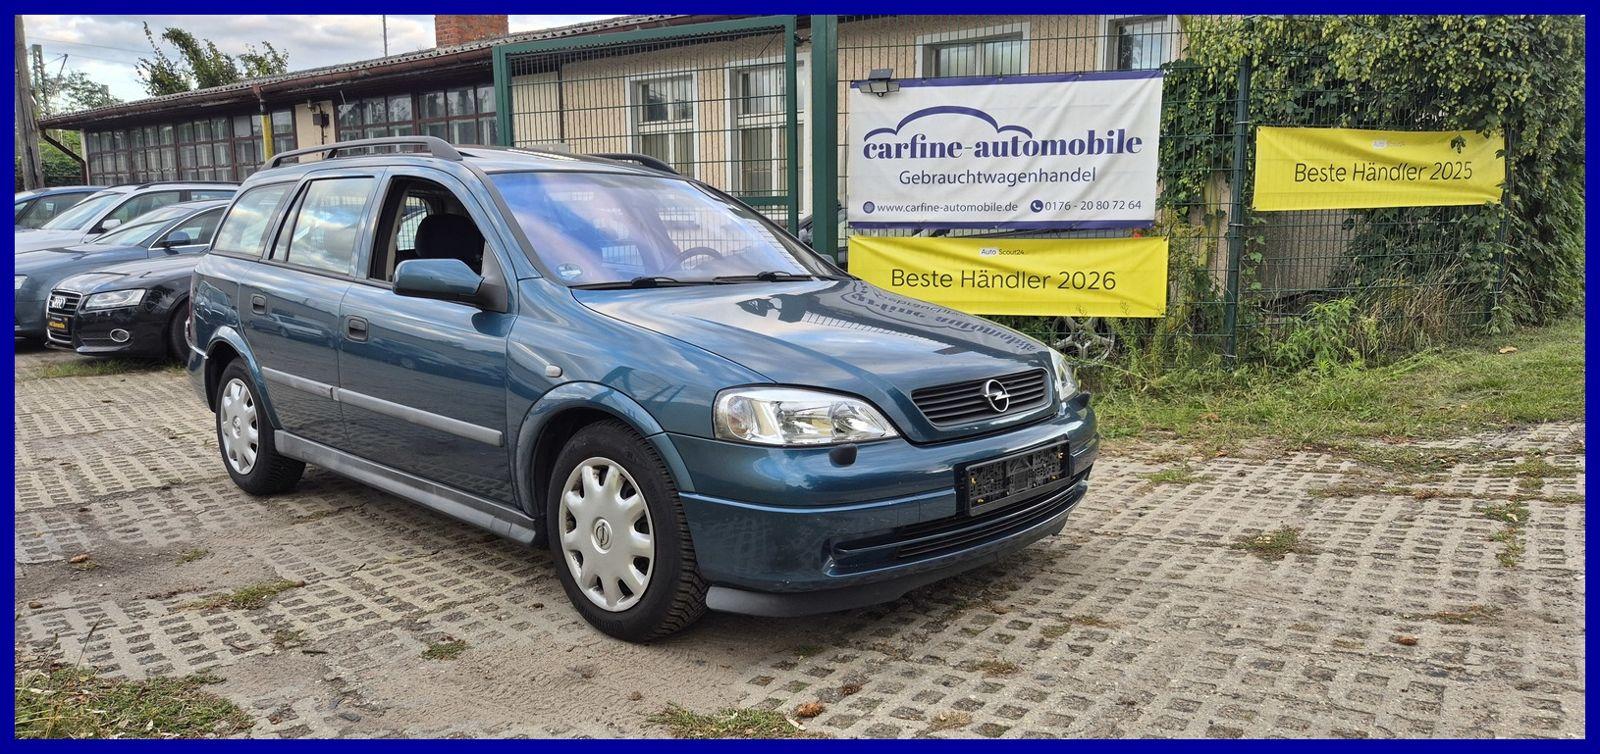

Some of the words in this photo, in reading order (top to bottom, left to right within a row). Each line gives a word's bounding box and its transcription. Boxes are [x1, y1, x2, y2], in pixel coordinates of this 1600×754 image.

[863, 128, 1143, 160] carfine-automobile
[899, 167, 1097, 188] Gebrauchtwagenhandel
[1294, 163, 1347, 183] Beste
[1352, 162, 1428, 182] Händler
[1429, 161, 1473, 181] 2025
[877, 201, 1018, 213] www.carfine-automobile.de
[1045, 201, 1071, 212] 0176
[1080, 201, 1094, 211] 20
[1095, 200, 1109, 211] 80
[1112, 200, 1126, 210] 72
[1128, 200, 1142, 210] 64
[891, 268, 953, 288] Beste
[961, 269, 1052, 290] Händler
[1057, 270, 1117, 291] 2026
